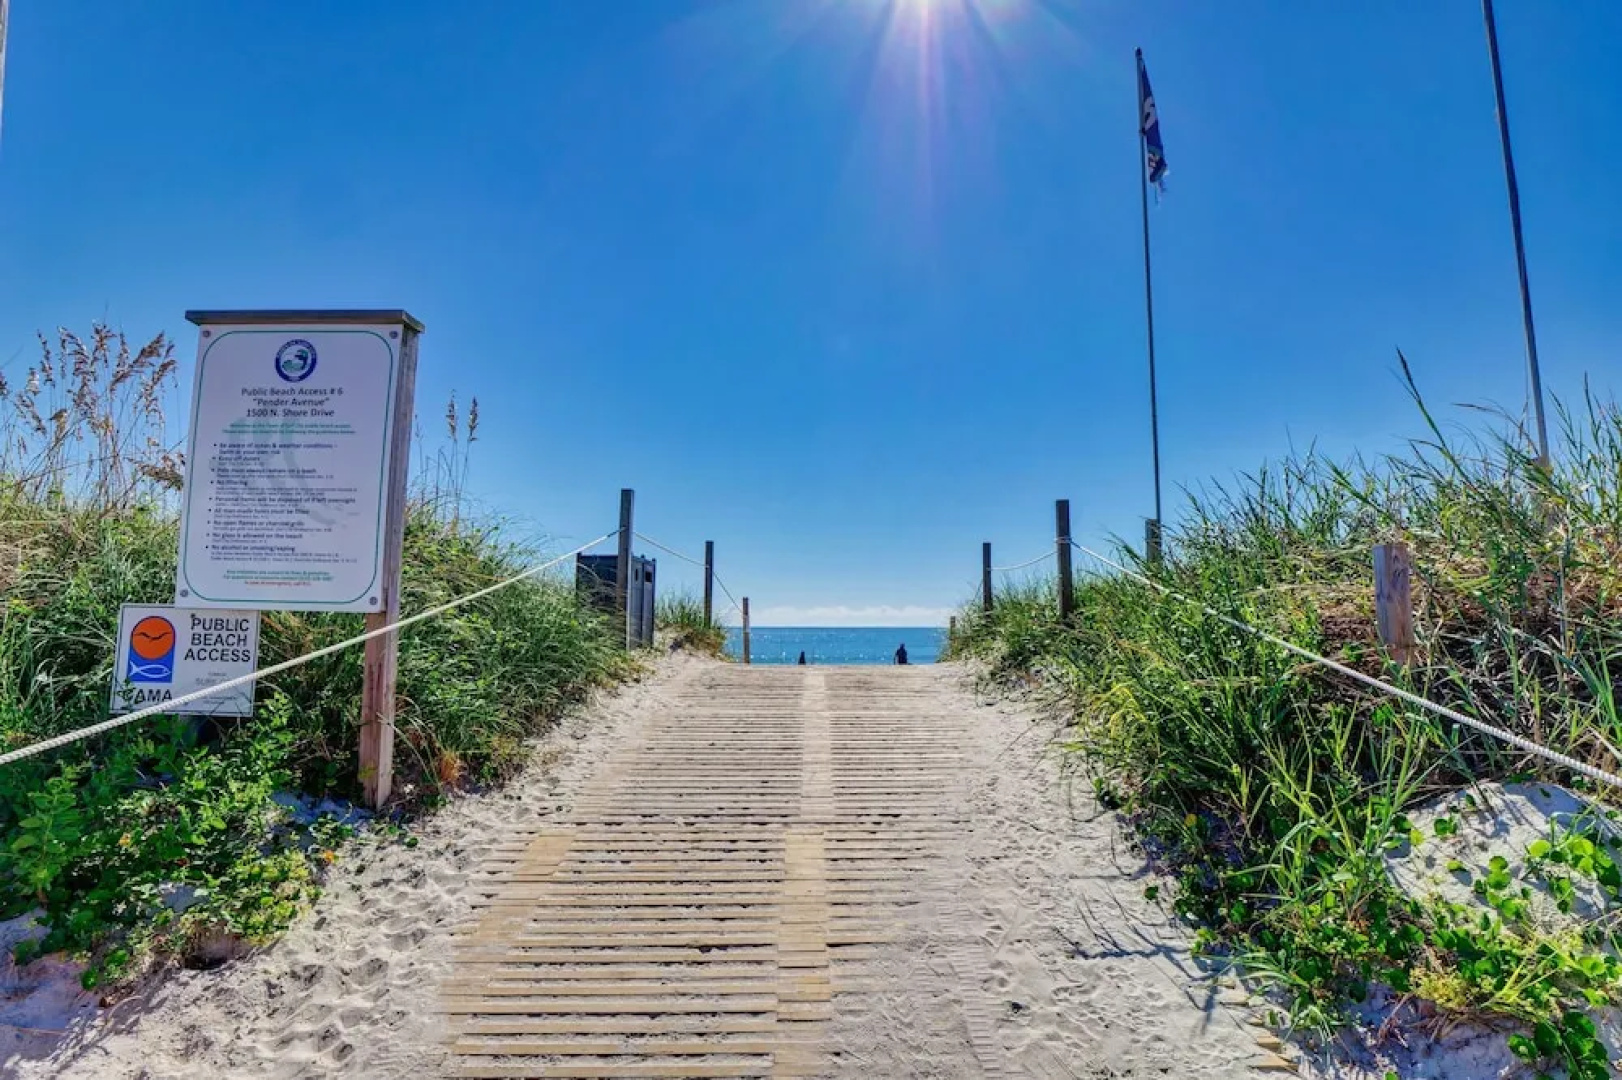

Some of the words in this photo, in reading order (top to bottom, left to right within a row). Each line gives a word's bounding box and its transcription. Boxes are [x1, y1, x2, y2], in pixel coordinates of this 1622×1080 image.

[241, 387, 267, 397] Public
[269, 387, 296, 396] Beach
[298, 387, 327, 396] Access
[329, 387, 335, 396] #
[337, 387, 344, 397] 6
[246, 408, 268, 418] 1500
[282, 408, 308, 417] Shore
[310, 408, 335, 417] Drive
[190, 617, 249, 632] PUBLIC
[190, 633, 248, 648] BEACH
[184, 648, 251, 662] ACCESS
